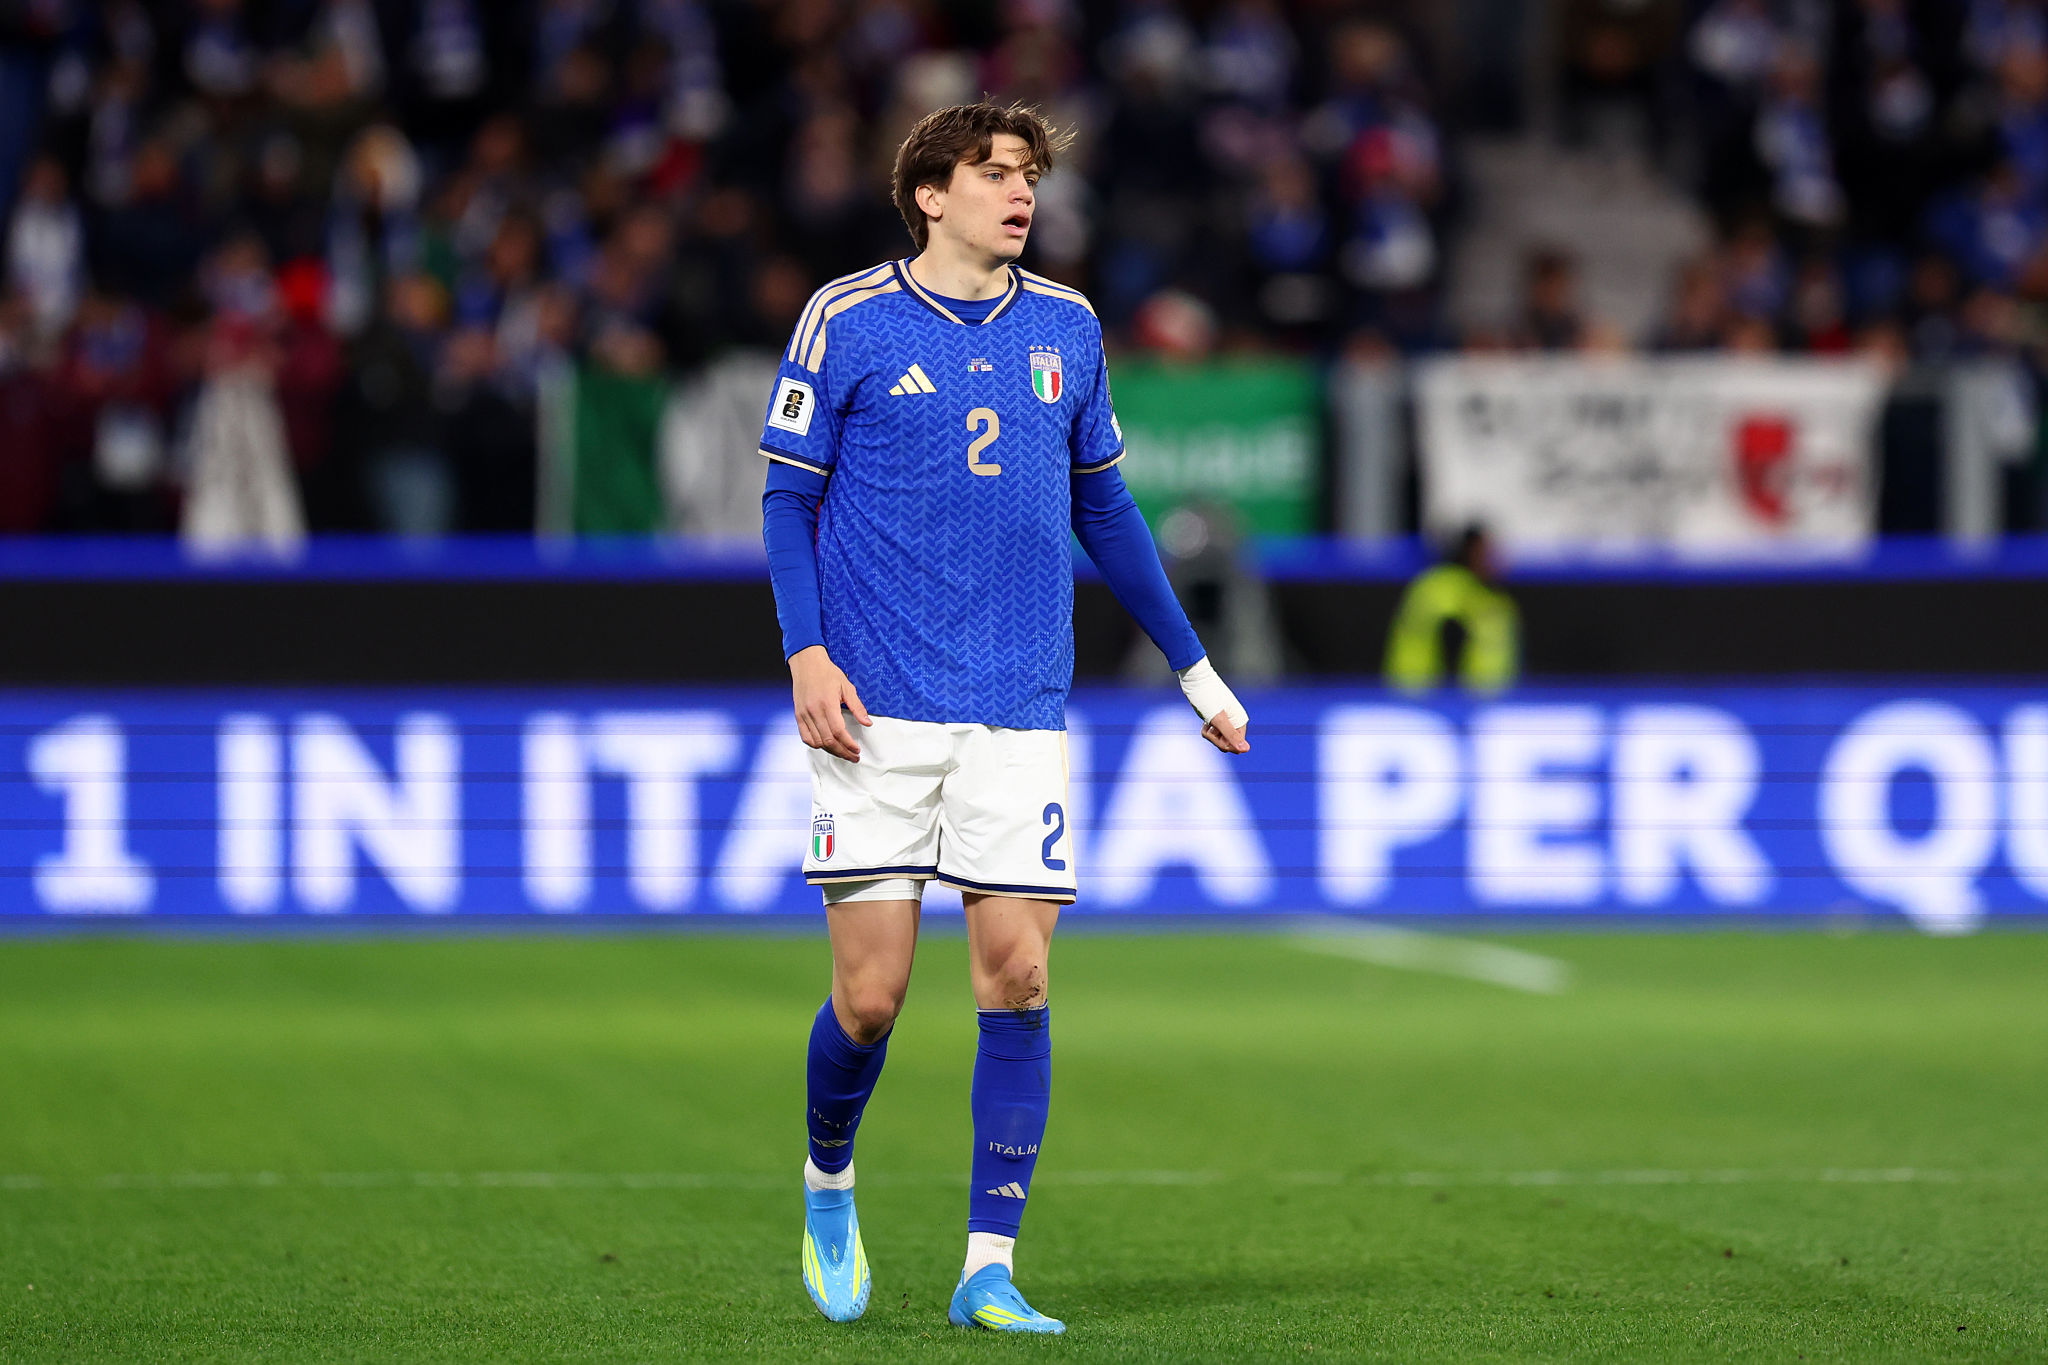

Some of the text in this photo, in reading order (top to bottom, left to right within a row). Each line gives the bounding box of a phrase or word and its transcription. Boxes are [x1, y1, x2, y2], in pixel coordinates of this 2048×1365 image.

[1032, 356, 1059, 367] ITALIA
[966, 407, 1002, 476] 2
[30, 701, 2048, 932] 1 IN ITAA PER Q
[814, 823, 832, 831] ITALIA
[1042, 802, 1066, 871] 2
[989, 1141, 1038, 1156] ITALIA
